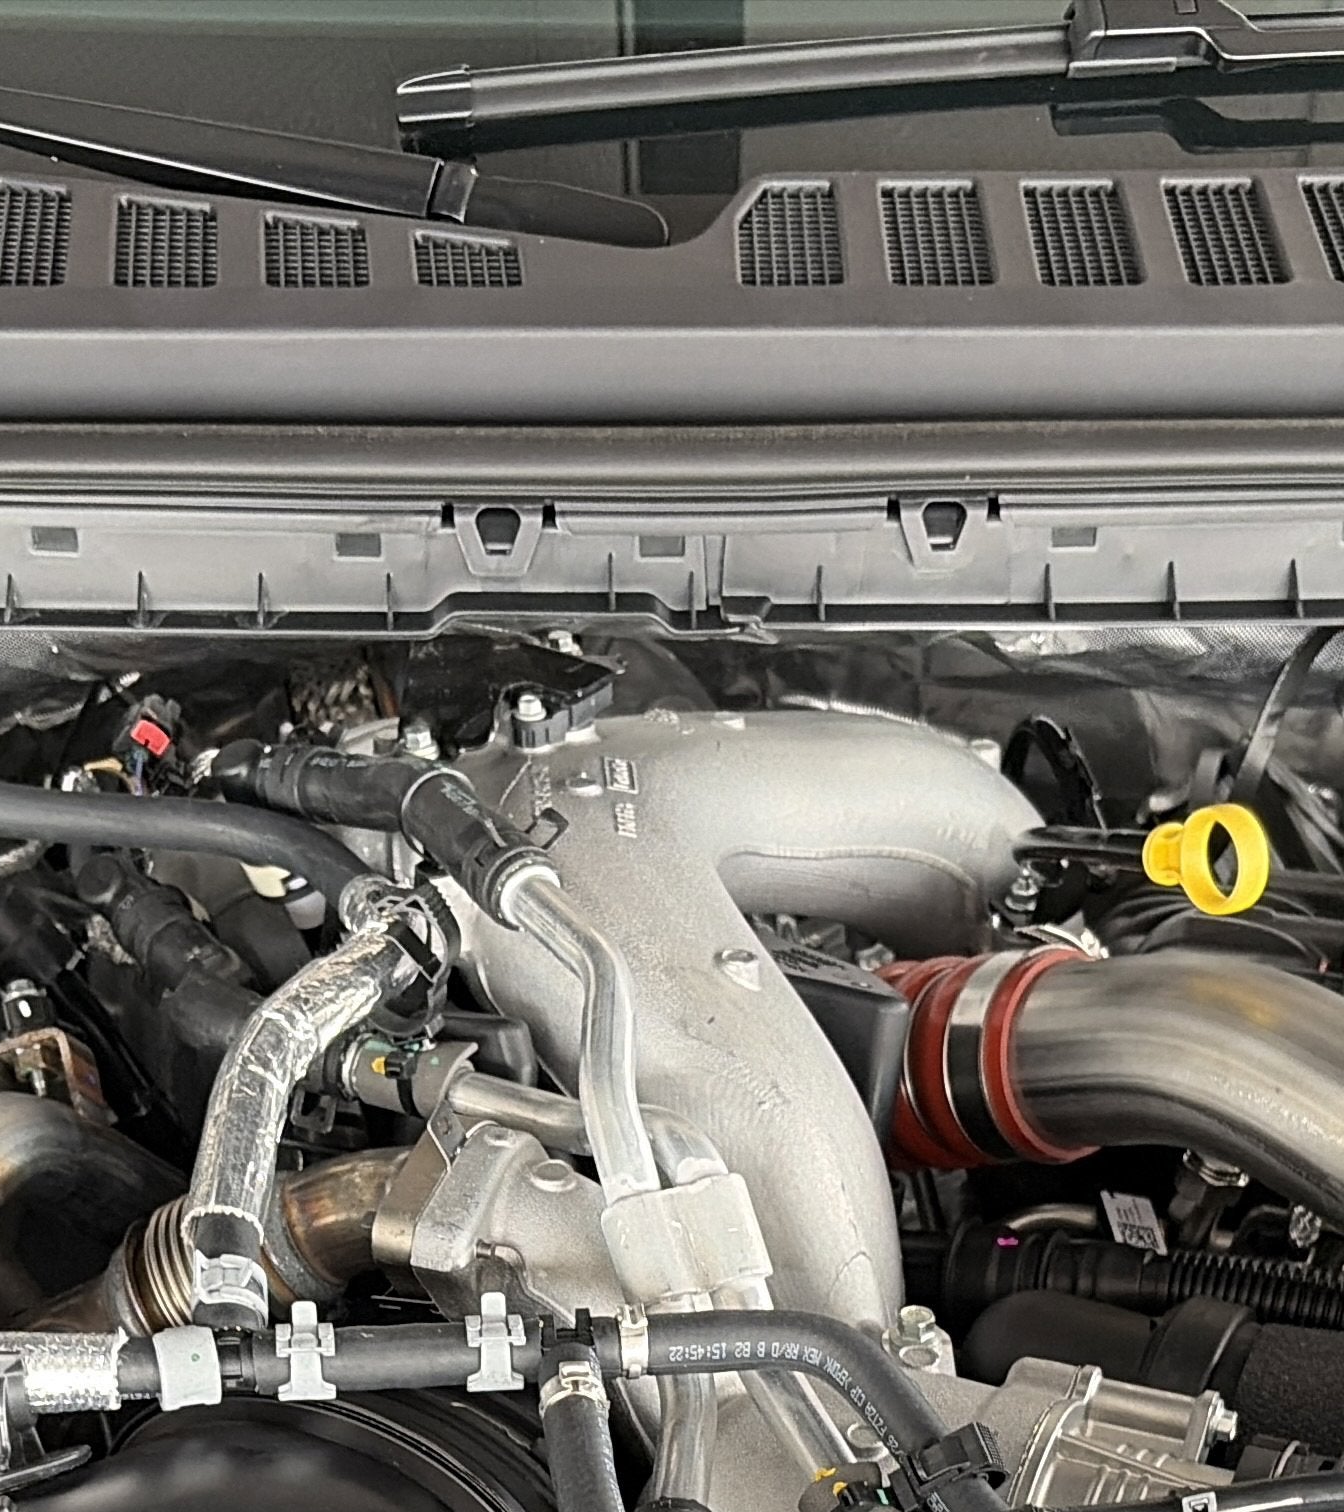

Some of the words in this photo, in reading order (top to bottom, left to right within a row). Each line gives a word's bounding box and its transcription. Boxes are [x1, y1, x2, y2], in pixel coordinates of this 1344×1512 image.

[668, 1342, 728, 1362] 15:45:22
[734, 1341, 752, 1358] B2
[756, 1341, 766, 1358] B
[849, 1385, 866, 1407] CIP
